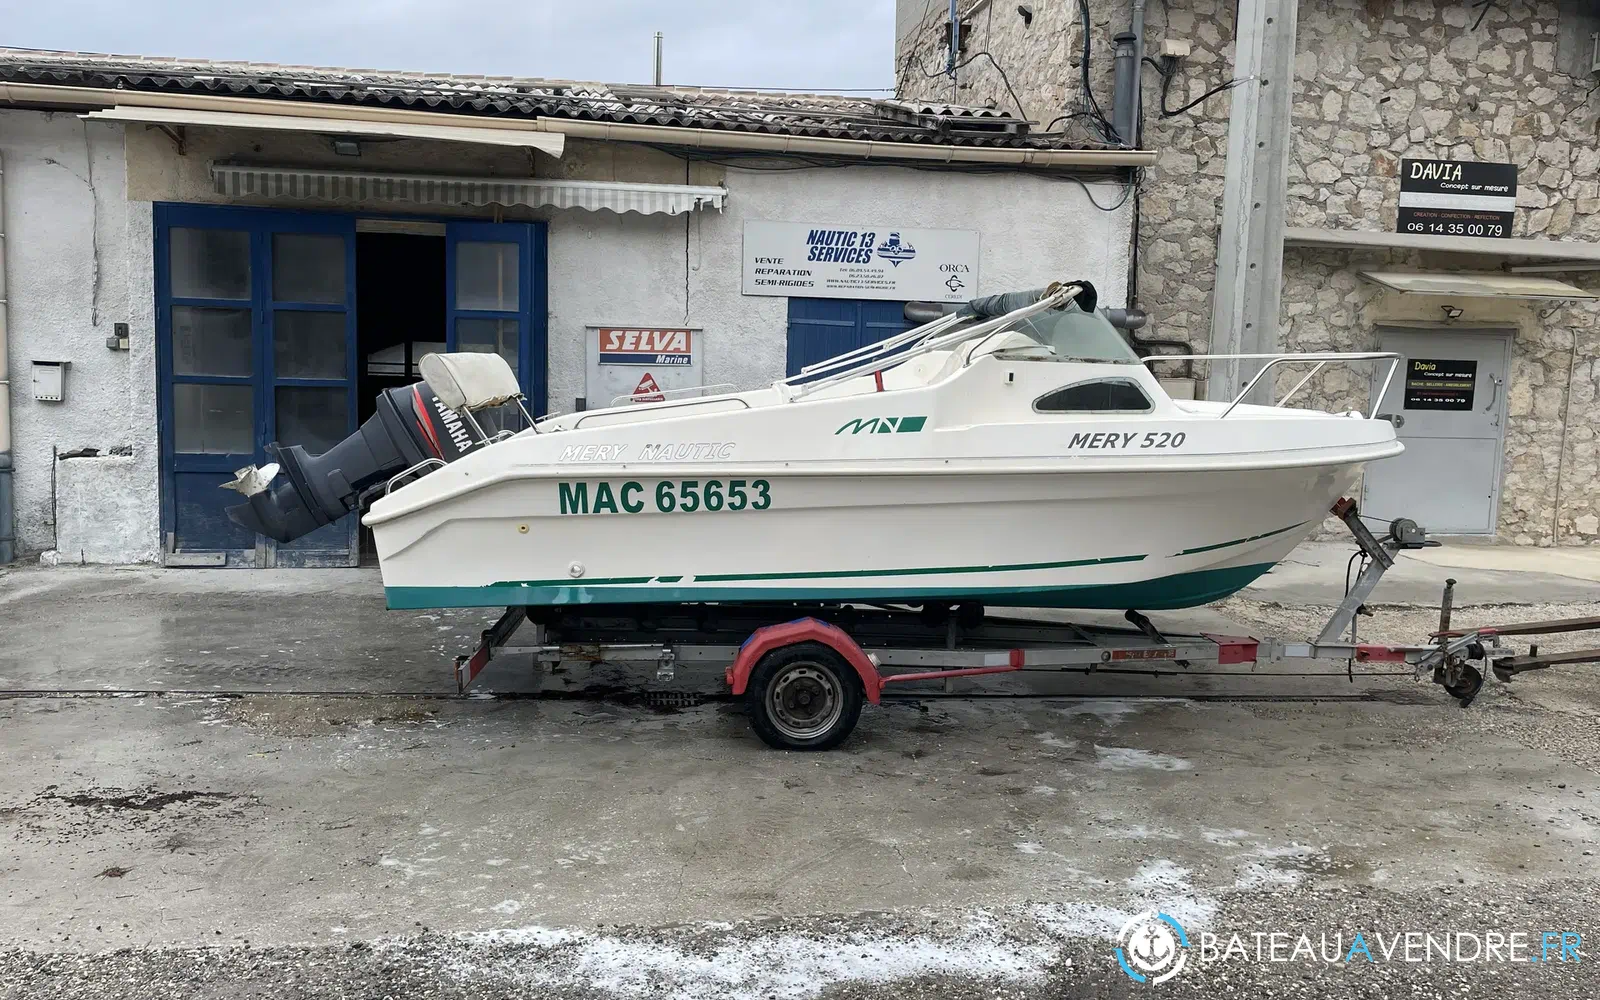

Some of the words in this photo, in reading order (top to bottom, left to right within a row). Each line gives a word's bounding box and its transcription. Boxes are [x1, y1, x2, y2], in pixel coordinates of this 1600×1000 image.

[1410, 162, 1462, 181] DAVIA
[1440, 182, 1469, 191] Concept
[1407, 222, 1424, 232] 06
[1429, 223, 1444, 233] 14
[1447, 223, 1464, 234] 35
[1467, 224, 1484, 235] 00
[1487, 224, 1503, 237] 79
[806, 230, 858, 247] NAUTIC
[860, 232, 876, 248] 13
[755, 257, 784, 265] VENTE
[807, 246, 873, 264] SERVICES
[755, 268, 812, 276] REPARATION
[939, 263, 970, 273] ORCA
[605, 331, 687, 351] SELVA
[655, 355, 689, 364] Marine
[1414, 361, 1436, 371] Davia
[1067, 432, 1138, 449] MERY
[1139, 432, 1186, 449] 520
[558, 444, 628, 462] MERY
[638, 442, 736, 461] NAUTIC
[558, 481, 645, 515] MAC
[655, 479, 772, 513] 65653
